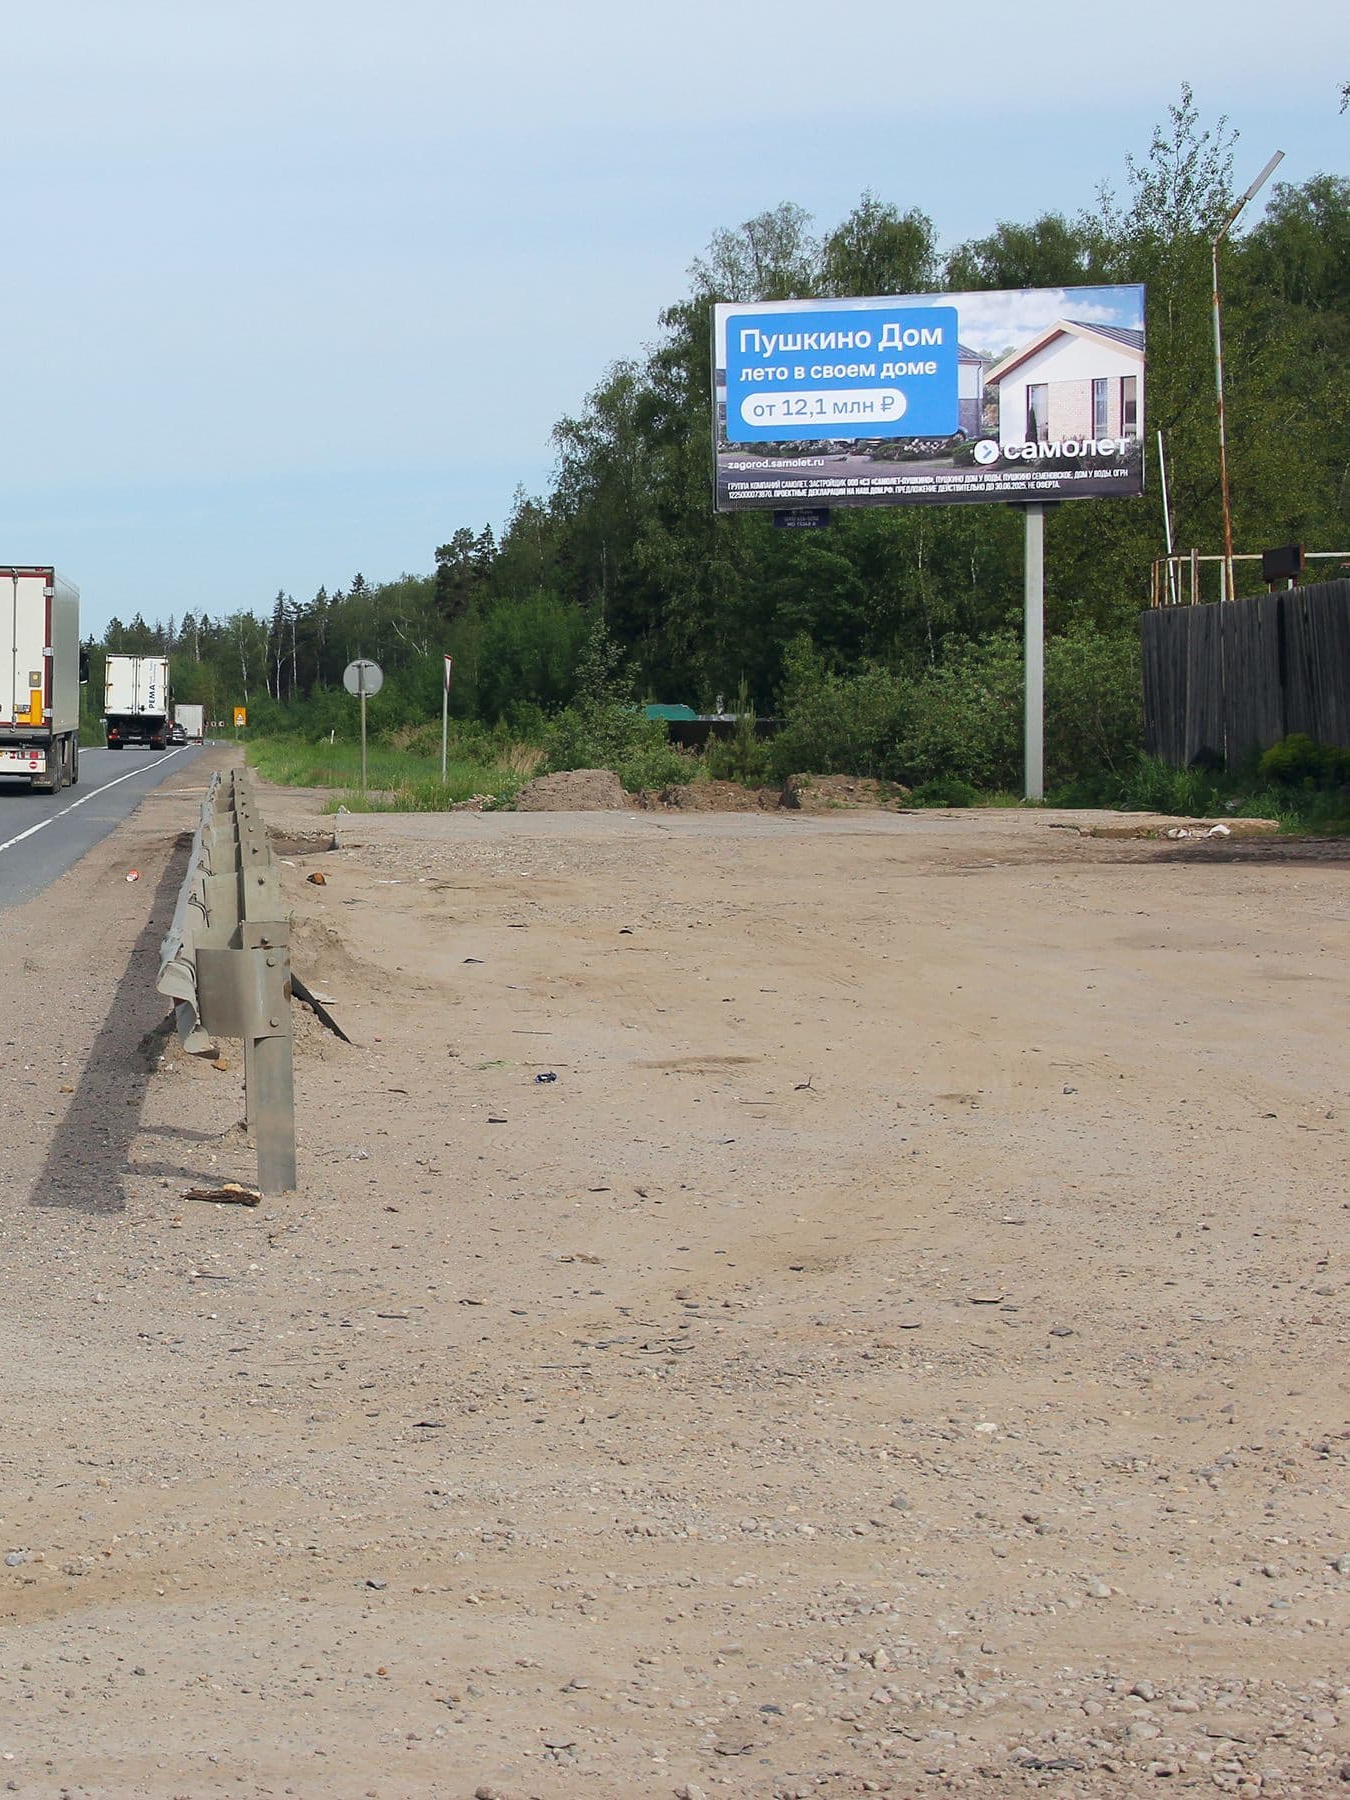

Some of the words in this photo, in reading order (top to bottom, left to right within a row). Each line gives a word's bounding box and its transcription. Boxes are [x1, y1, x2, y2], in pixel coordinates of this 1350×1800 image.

[739, 328, 871, 358] Пушкино
[878, 323, 943, 352] Дом
[739, 366, 788, 382] лето
[794, 366, 805, 379] в
[810, 363, 875, 379] своем
[880, 360, 937, 379] доме
[753, 404, 776, 417] от
[781, 398, 827, 419] 12,1
[833, 399, 874, 415] млн
[1004, 438, 1130, 460] самолет
[727, 459, 825, 471] zagorod.samolet.ru
[148, 684, 156, 709] PEMA
